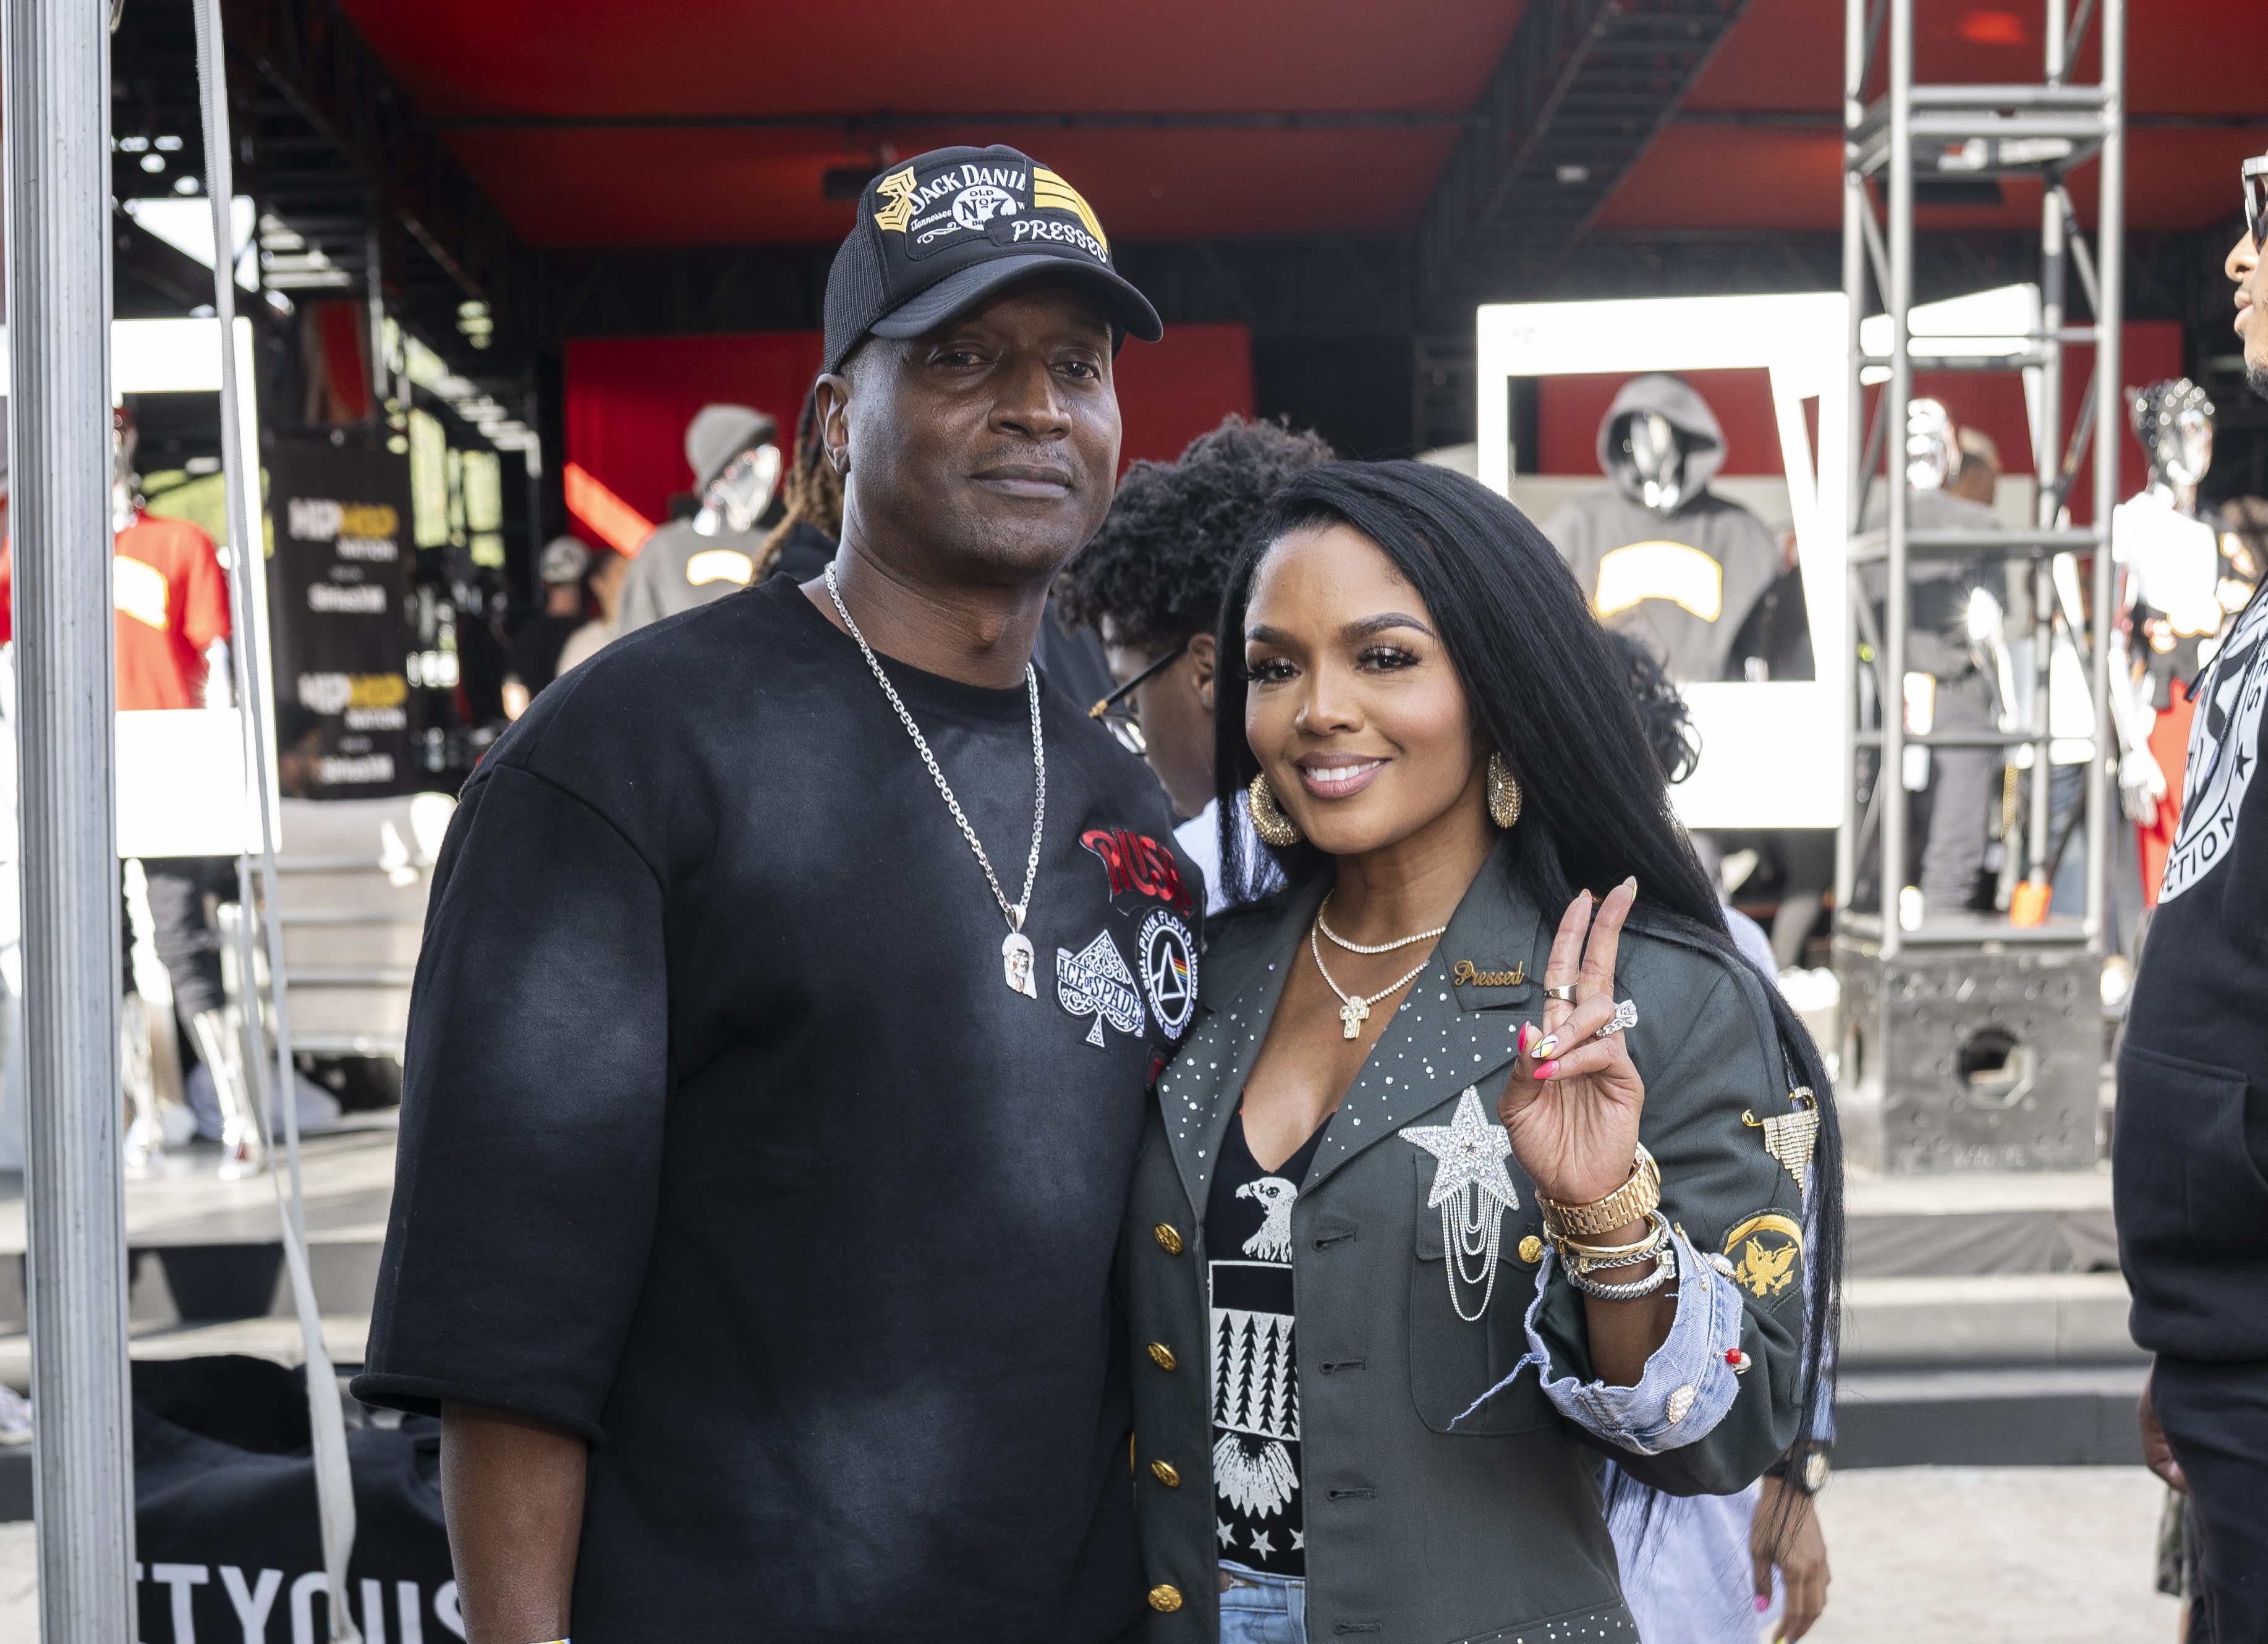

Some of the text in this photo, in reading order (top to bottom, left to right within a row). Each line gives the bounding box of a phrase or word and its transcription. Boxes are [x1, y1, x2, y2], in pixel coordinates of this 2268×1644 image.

[909, 172, 964, 216] JACK
[1011, 219, 1107, 263] PRESSED
[1139, 910, 1192, 952] PINK FLOYD
[1058, 959, 1145, 1024] ACE OF SPADES
[1454, 960, 1525, 986] Pressed
